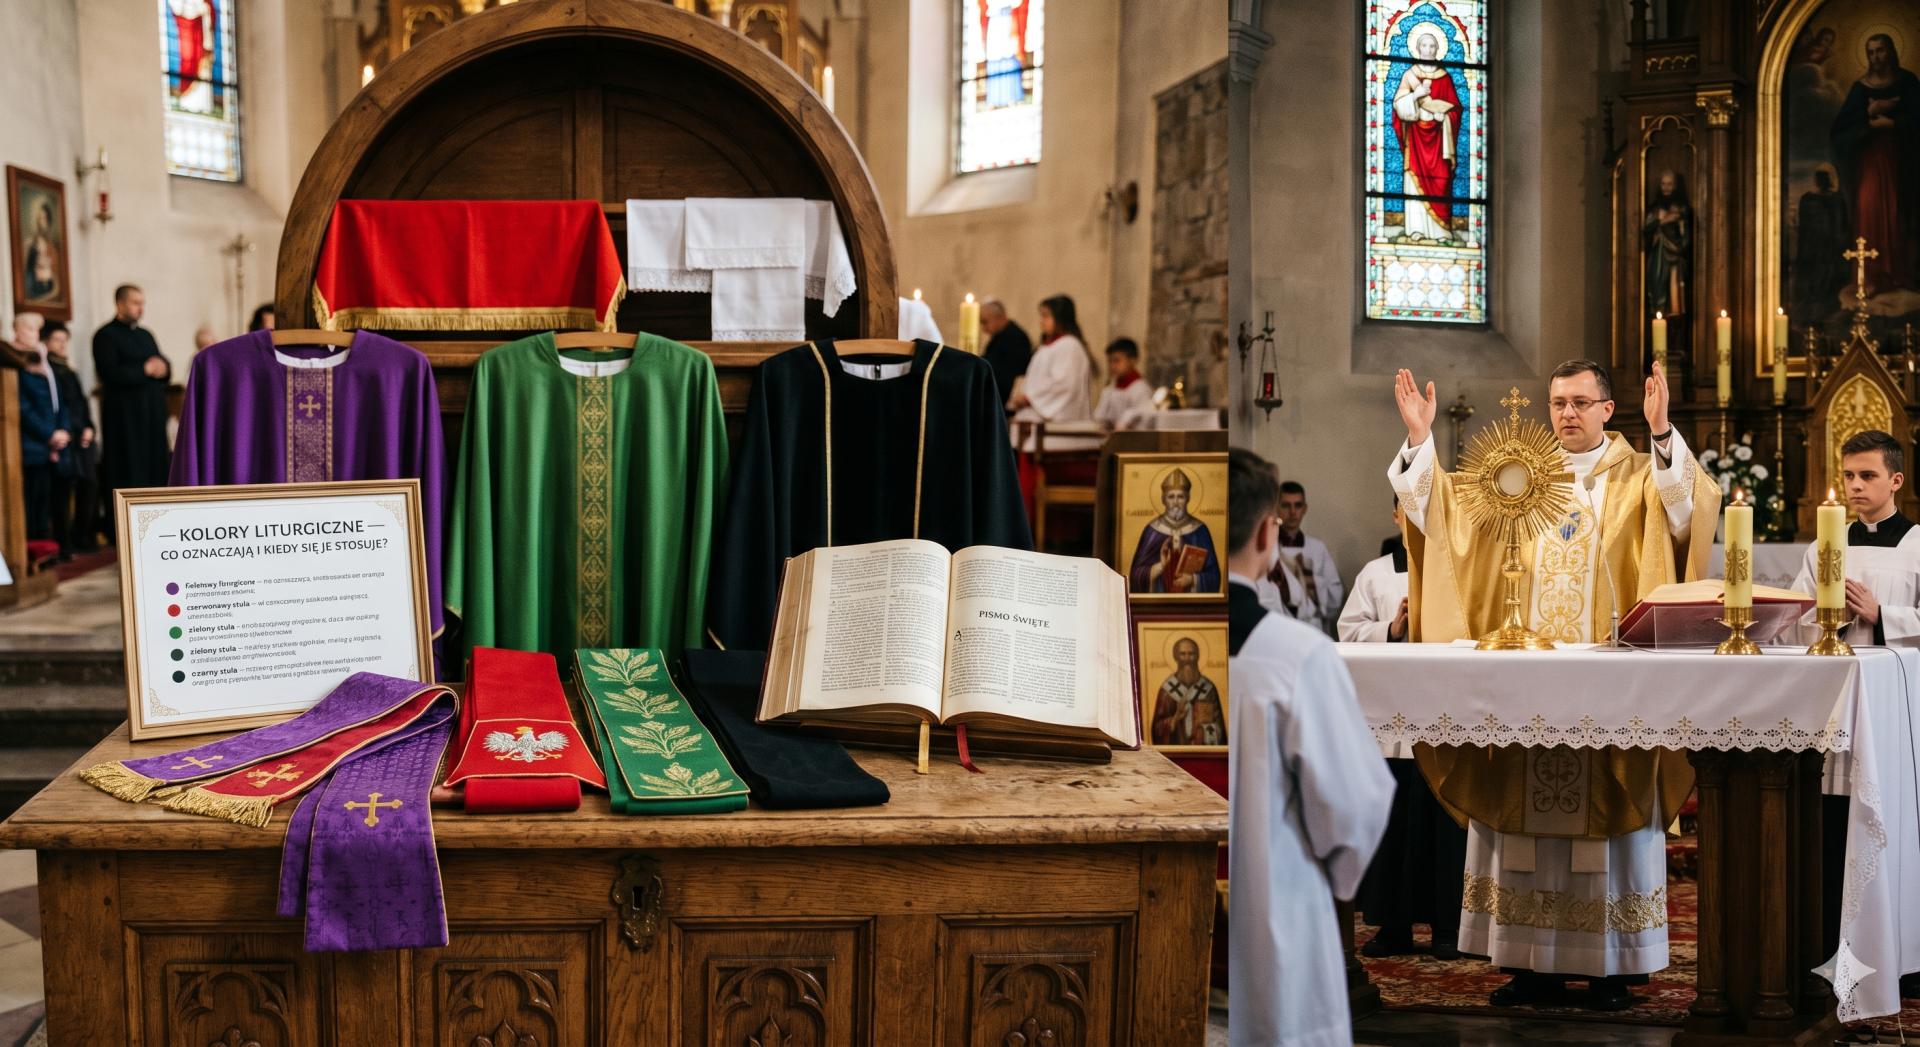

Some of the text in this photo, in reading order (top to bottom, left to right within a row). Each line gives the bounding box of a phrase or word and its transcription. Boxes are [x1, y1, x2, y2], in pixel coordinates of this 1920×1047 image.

[179, 520, 364, 542] KOLORY LITURGICZNE
[160, 538, 389, 560] CO OZNACZAJĄ I KIEDY SIĘ JE STOSUJE?
[979, 610, 1050, 628] PISMO ŚWIĘTE
[188, 625, 215, 633] zielony
[190, 647, 217, 655] zielony
[191, 669, 218, 677] czarny
